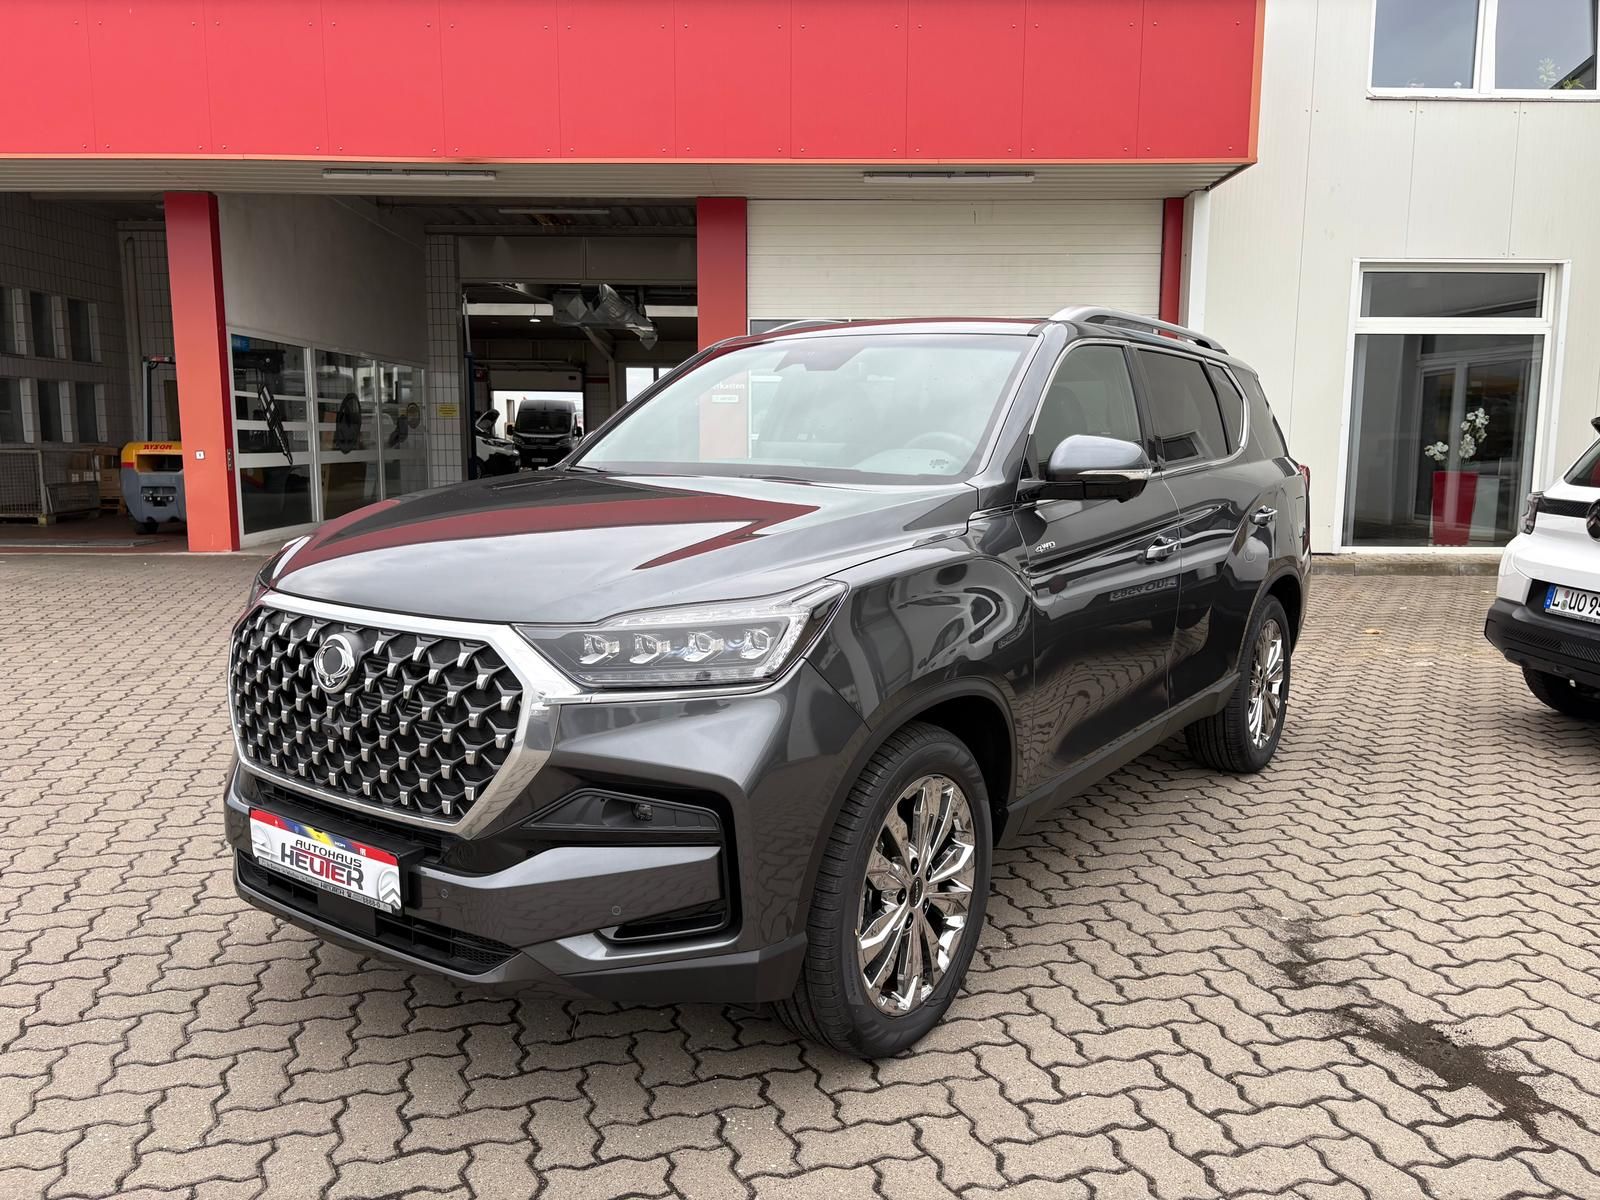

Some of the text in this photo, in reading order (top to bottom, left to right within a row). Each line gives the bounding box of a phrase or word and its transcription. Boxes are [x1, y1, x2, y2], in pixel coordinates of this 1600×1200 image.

[1035, 541, 1056, 553] 4WD
[1552, 588, 1560, 607] L
[1568, 592, 1587, 613] UO
[281, 843, 364, 890] HEUTER
[295, 839, 362, 868] AUTOHAUS
